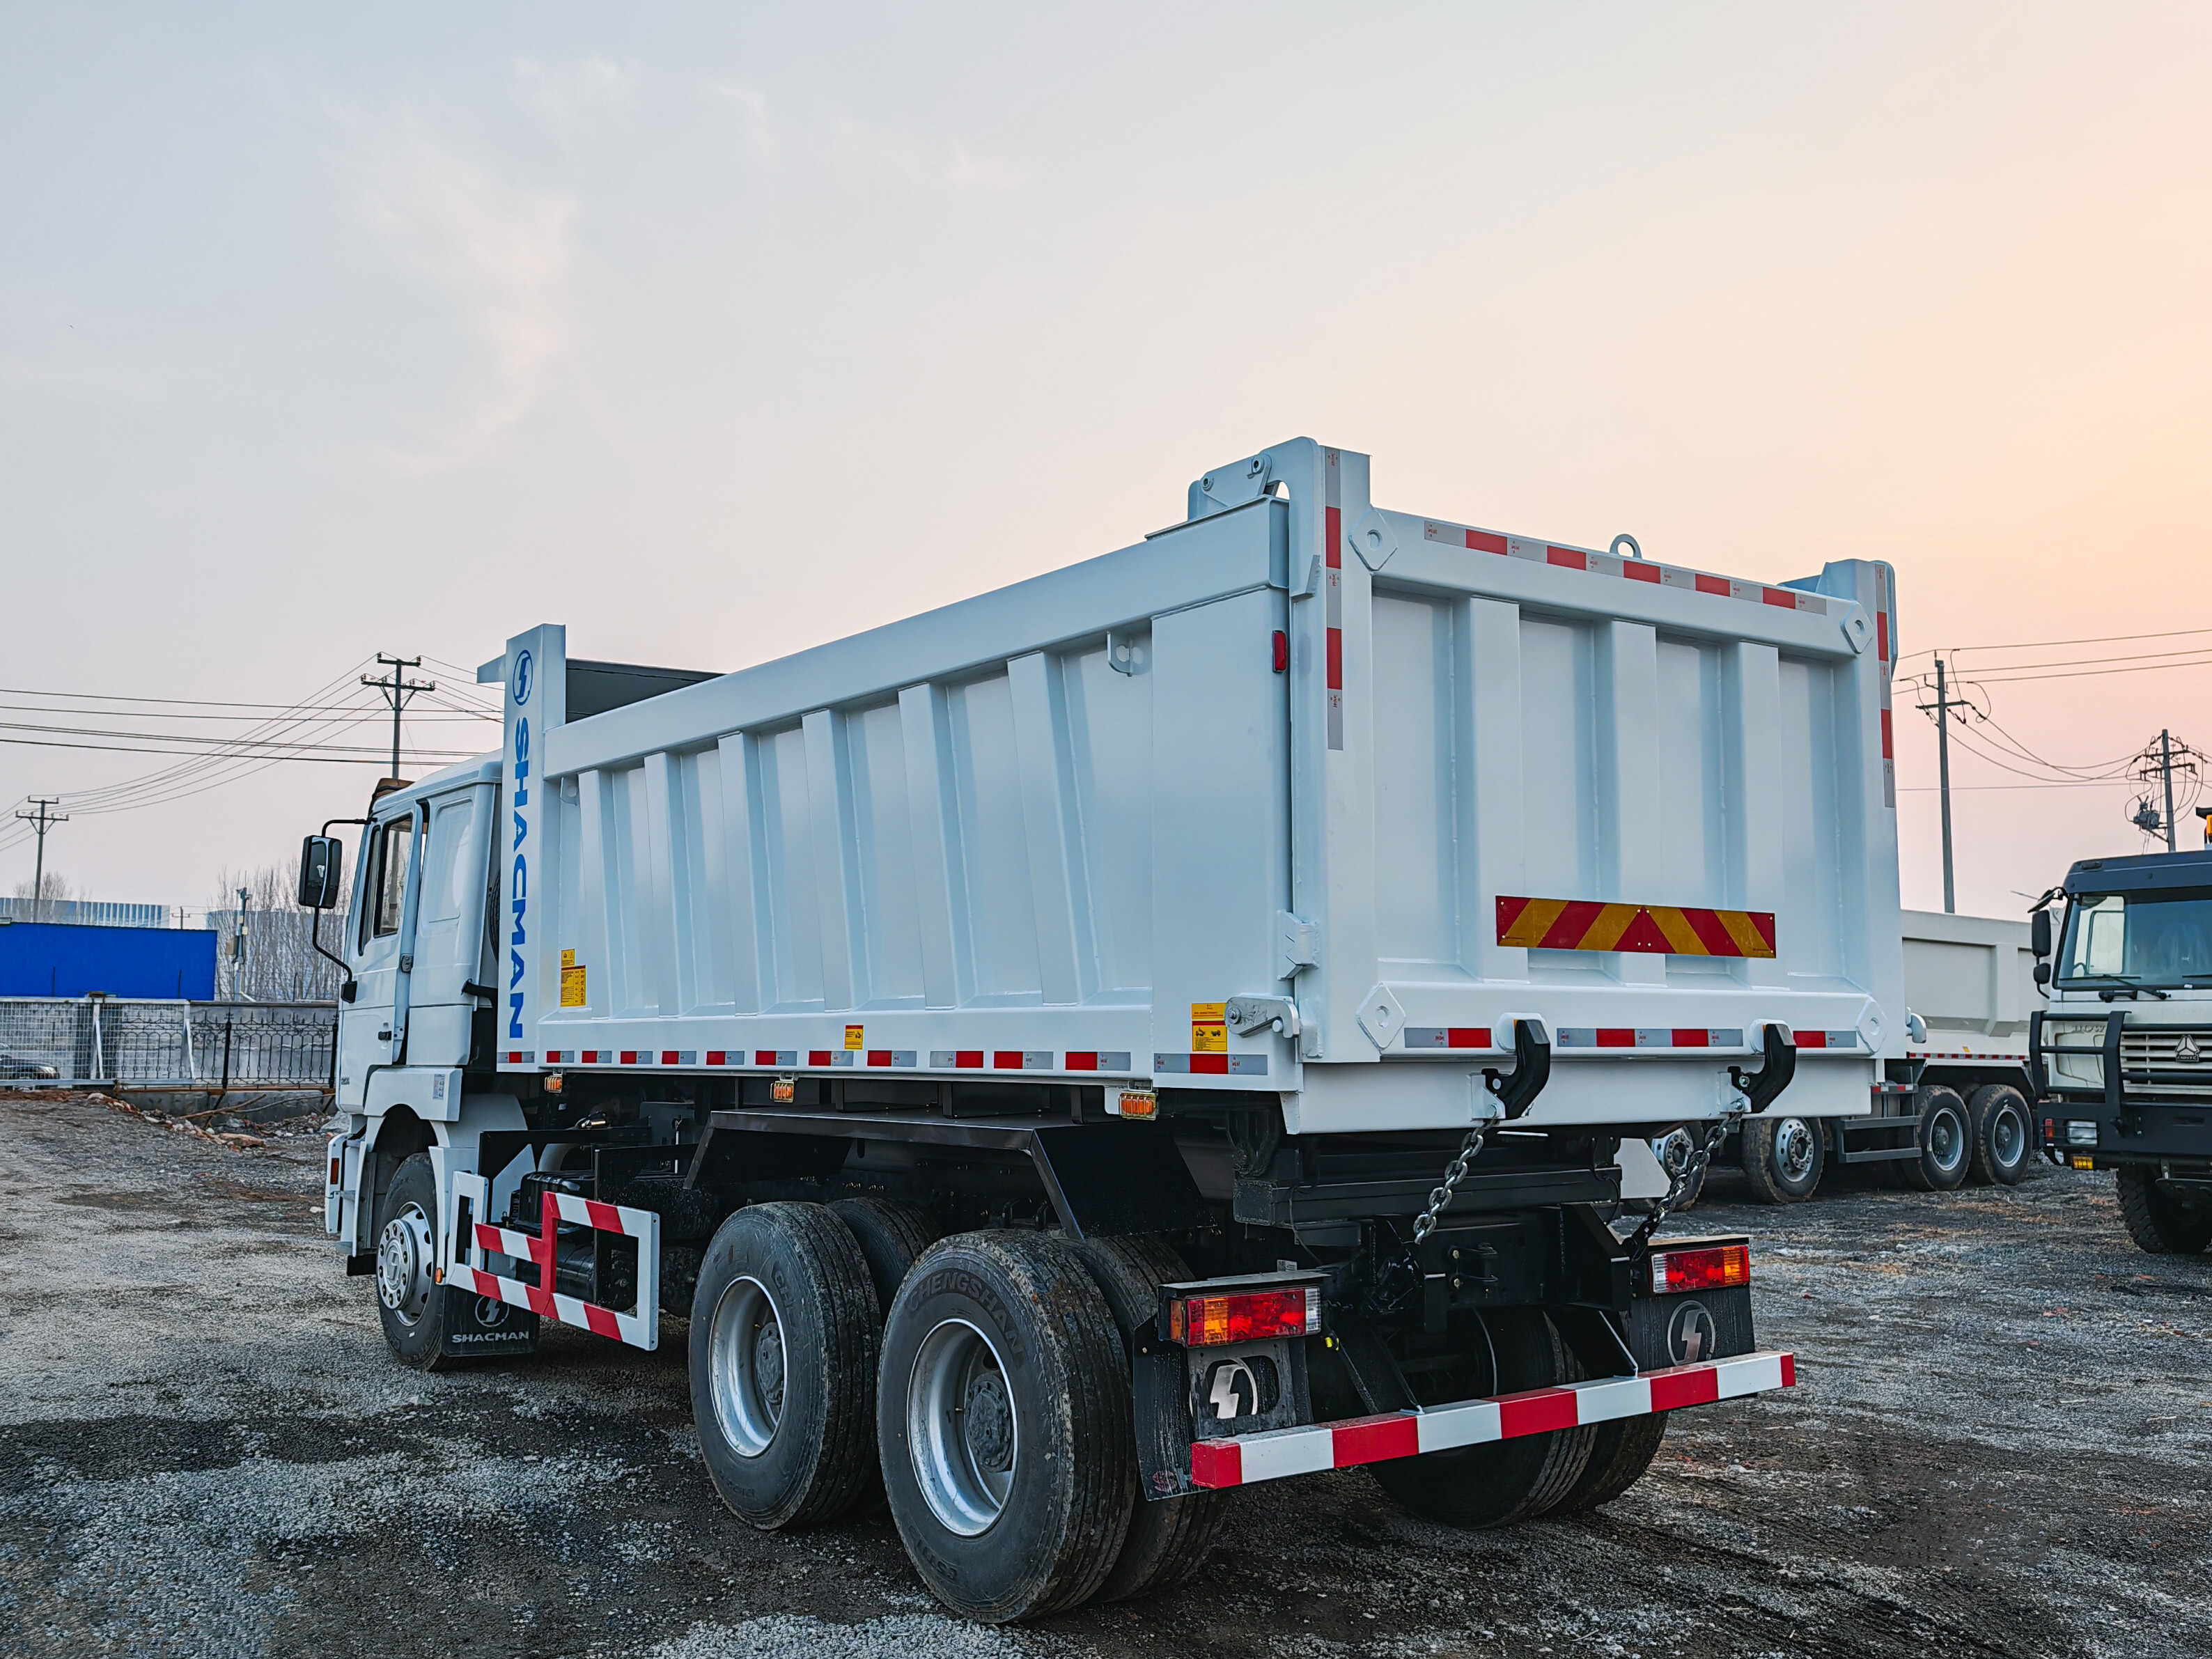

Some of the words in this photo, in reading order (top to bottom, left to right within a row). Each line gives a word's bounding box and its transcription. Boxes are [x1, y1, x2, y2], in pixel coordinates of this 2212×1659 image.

[508, 716, 531, 1039] SHACMAN
[2071, 1025, 2107, 1034] HOW
[451, 1331, 529, 1343] SHACMAN
[908, 1272, 1024, 1357] CHENGSHAN
